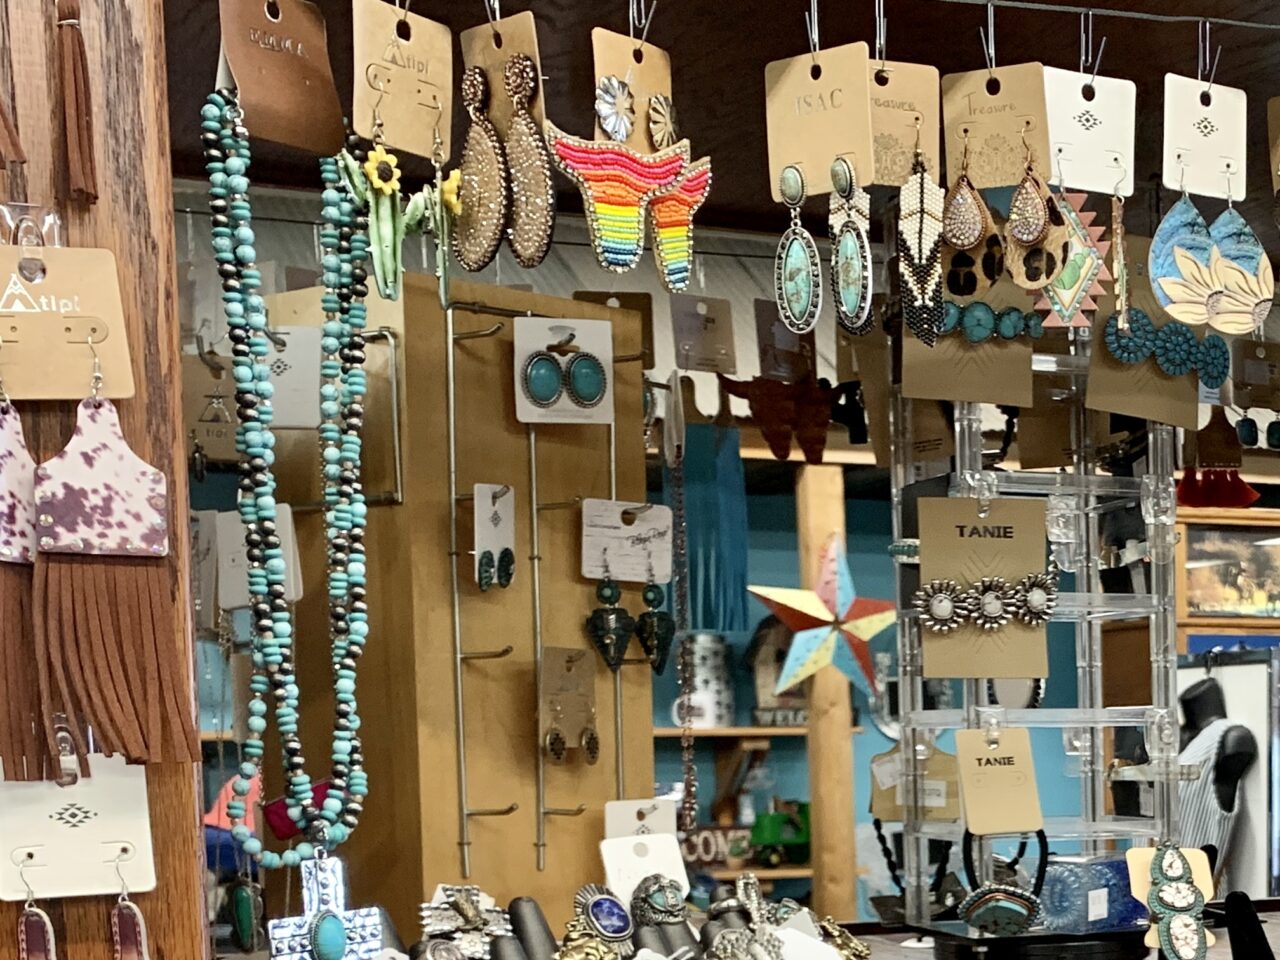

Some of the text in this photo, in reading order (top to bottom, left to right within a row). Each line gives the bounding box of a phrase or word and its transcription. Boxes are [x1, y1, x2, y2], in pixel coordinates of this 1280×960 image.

[961, 91, 1017, 117] Treasure
[40, 295, 80, 314] tipi
[955, 525, 1015, 540] TANIE
[976, 756, 1016, 768] TANIE
